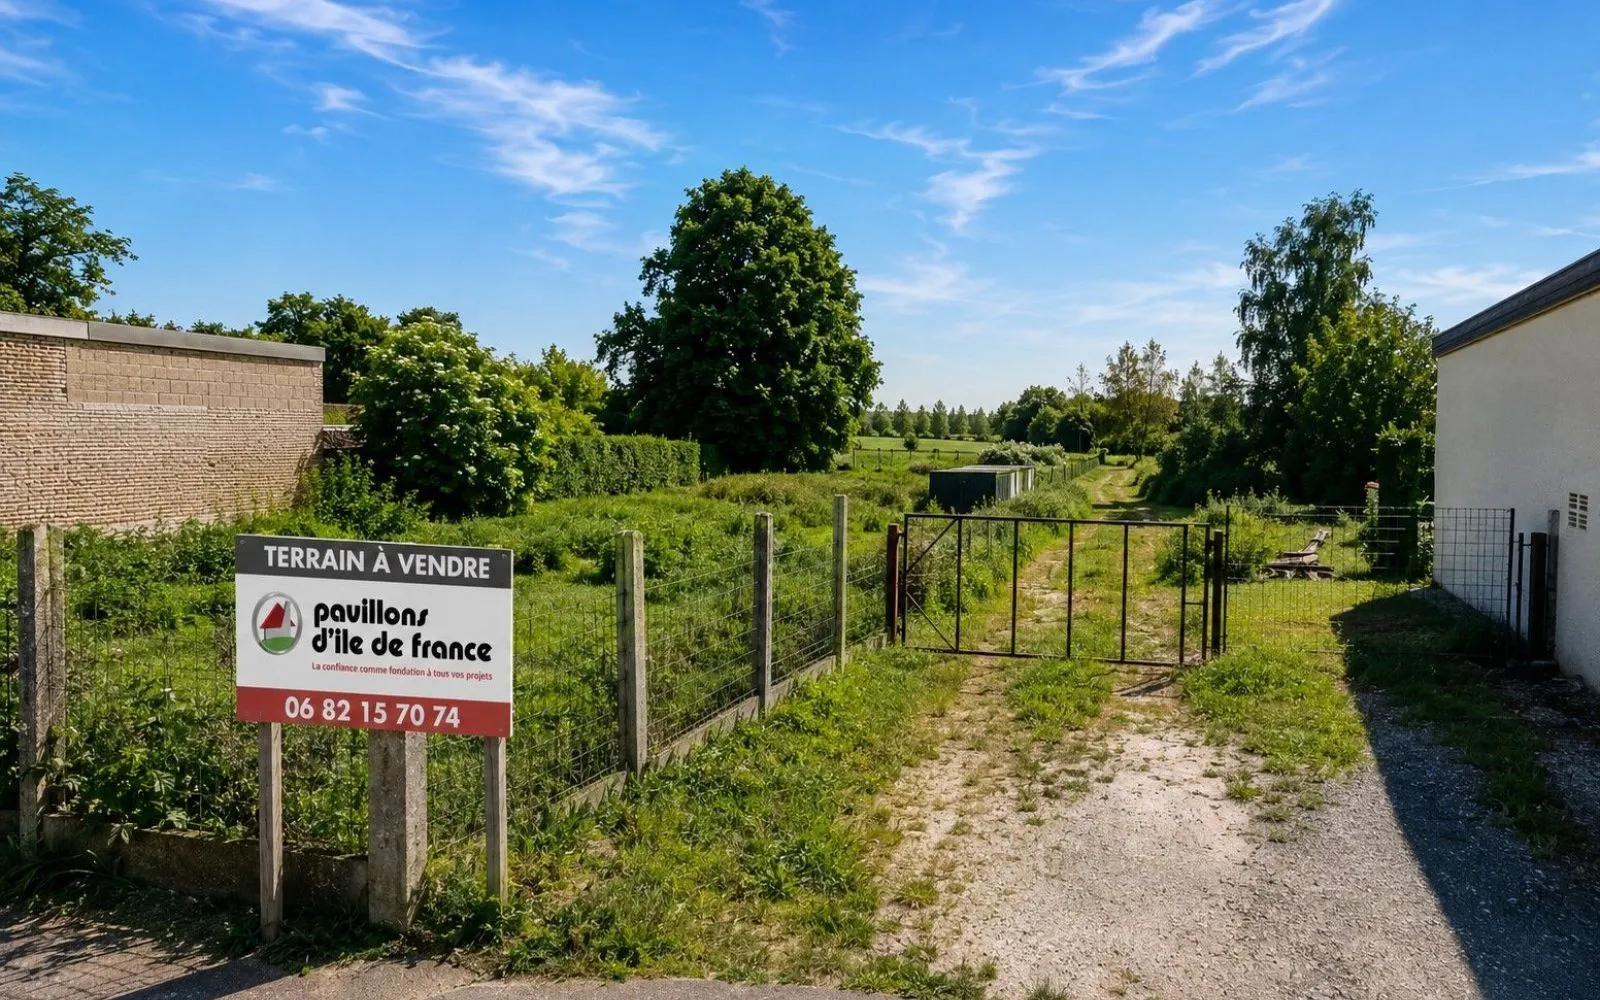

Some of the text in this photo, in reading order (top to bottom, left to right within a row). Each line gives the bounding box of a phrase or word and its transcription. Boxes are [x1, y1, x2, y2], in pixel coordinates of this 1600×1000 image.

[264, 545, 490, 579] TERRAIN À VENDRE
[314, 598, 428, 628] pavillons
[371, 630, 404, 658] de
[411, 632, 493, 662] france
[312, 662, 321, 670] La
[322, 662, 358, 672] confiance
[360, 665, 387, 674] comme
[389, 666, 425, 676] fondation
[426, 668, 432, 676] à
[433, 669, 450, 678] tous
[466, 671, 493, 681] projets
[284, 695, 460, 729] 06 82 15 70 74
